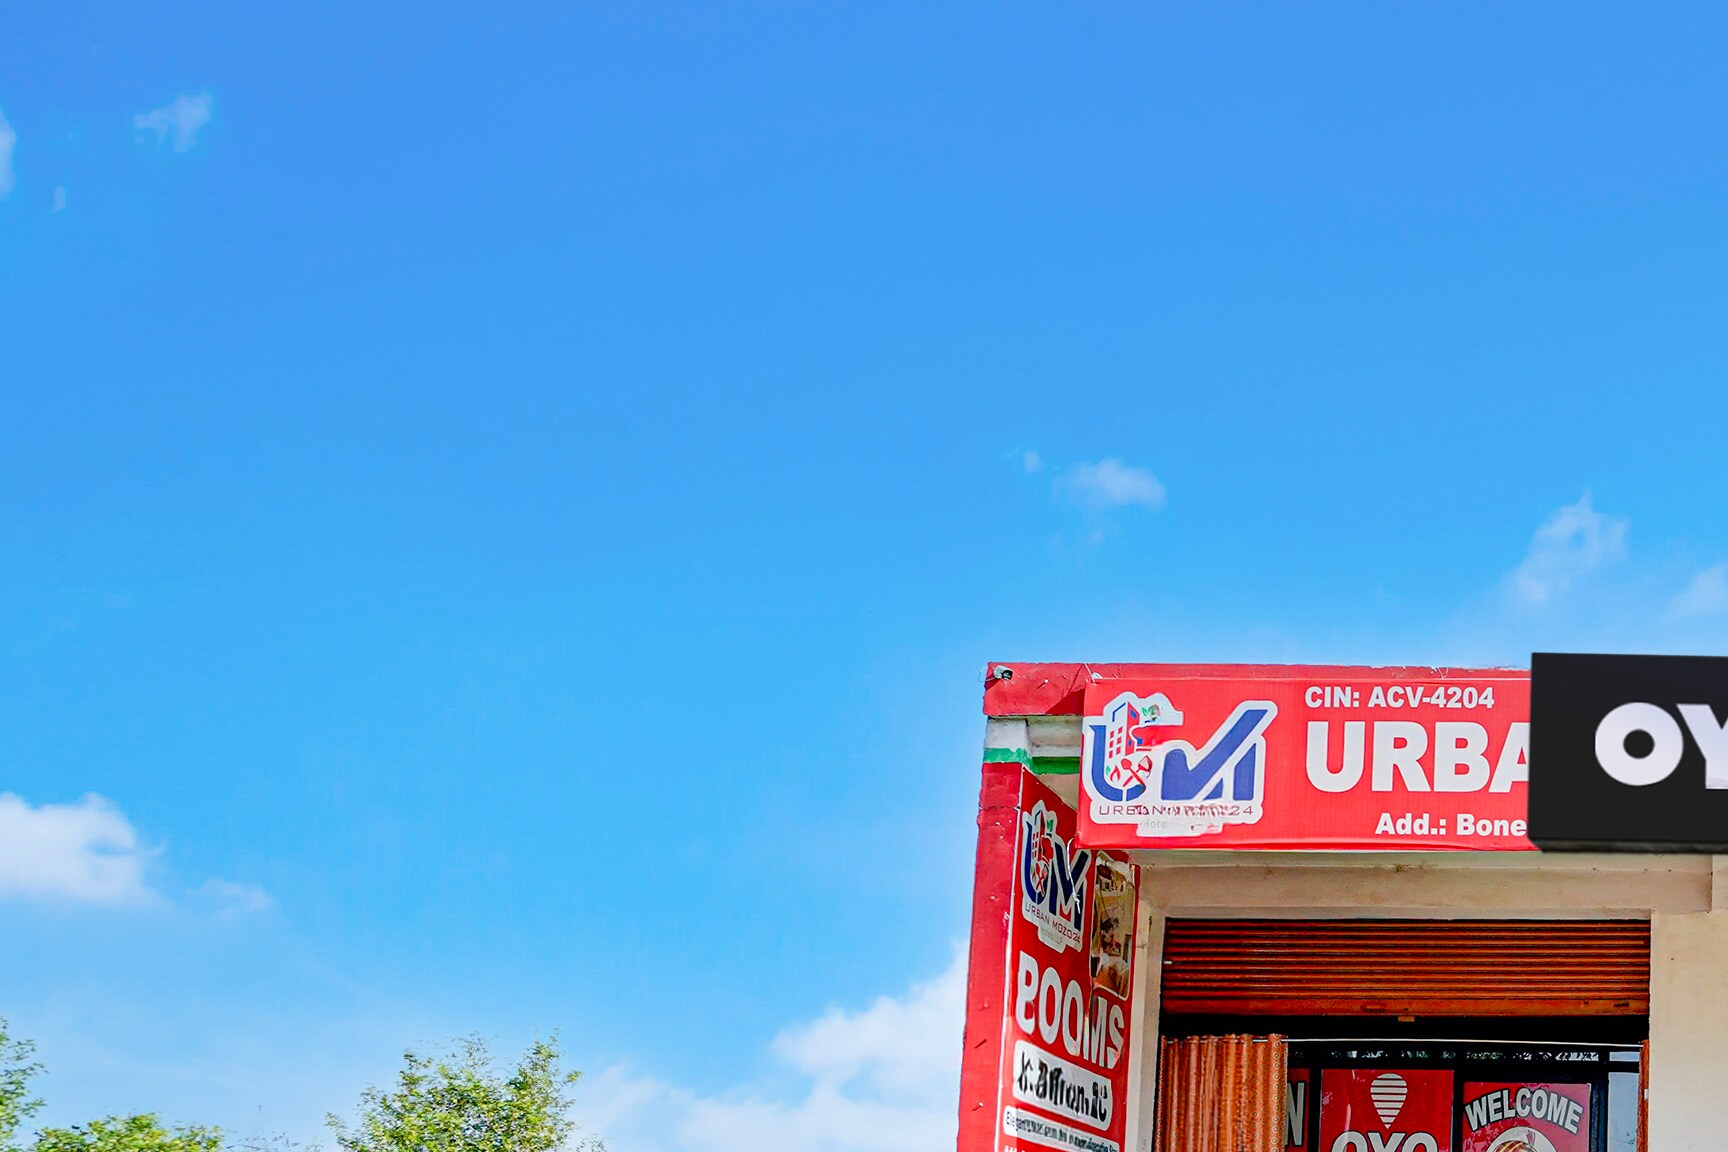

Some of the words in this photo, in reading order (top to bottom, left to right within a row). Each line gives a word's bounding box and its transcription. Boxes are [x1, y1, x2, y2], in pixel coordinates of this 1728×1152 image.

[1305, 686, 1359, 708] CIN:
[1367, 686, 1495, 709] ACV-4204
[1375, 813, 1447, 835] Add.:
[1464, 1087, 1584, 1135] WELCOME
